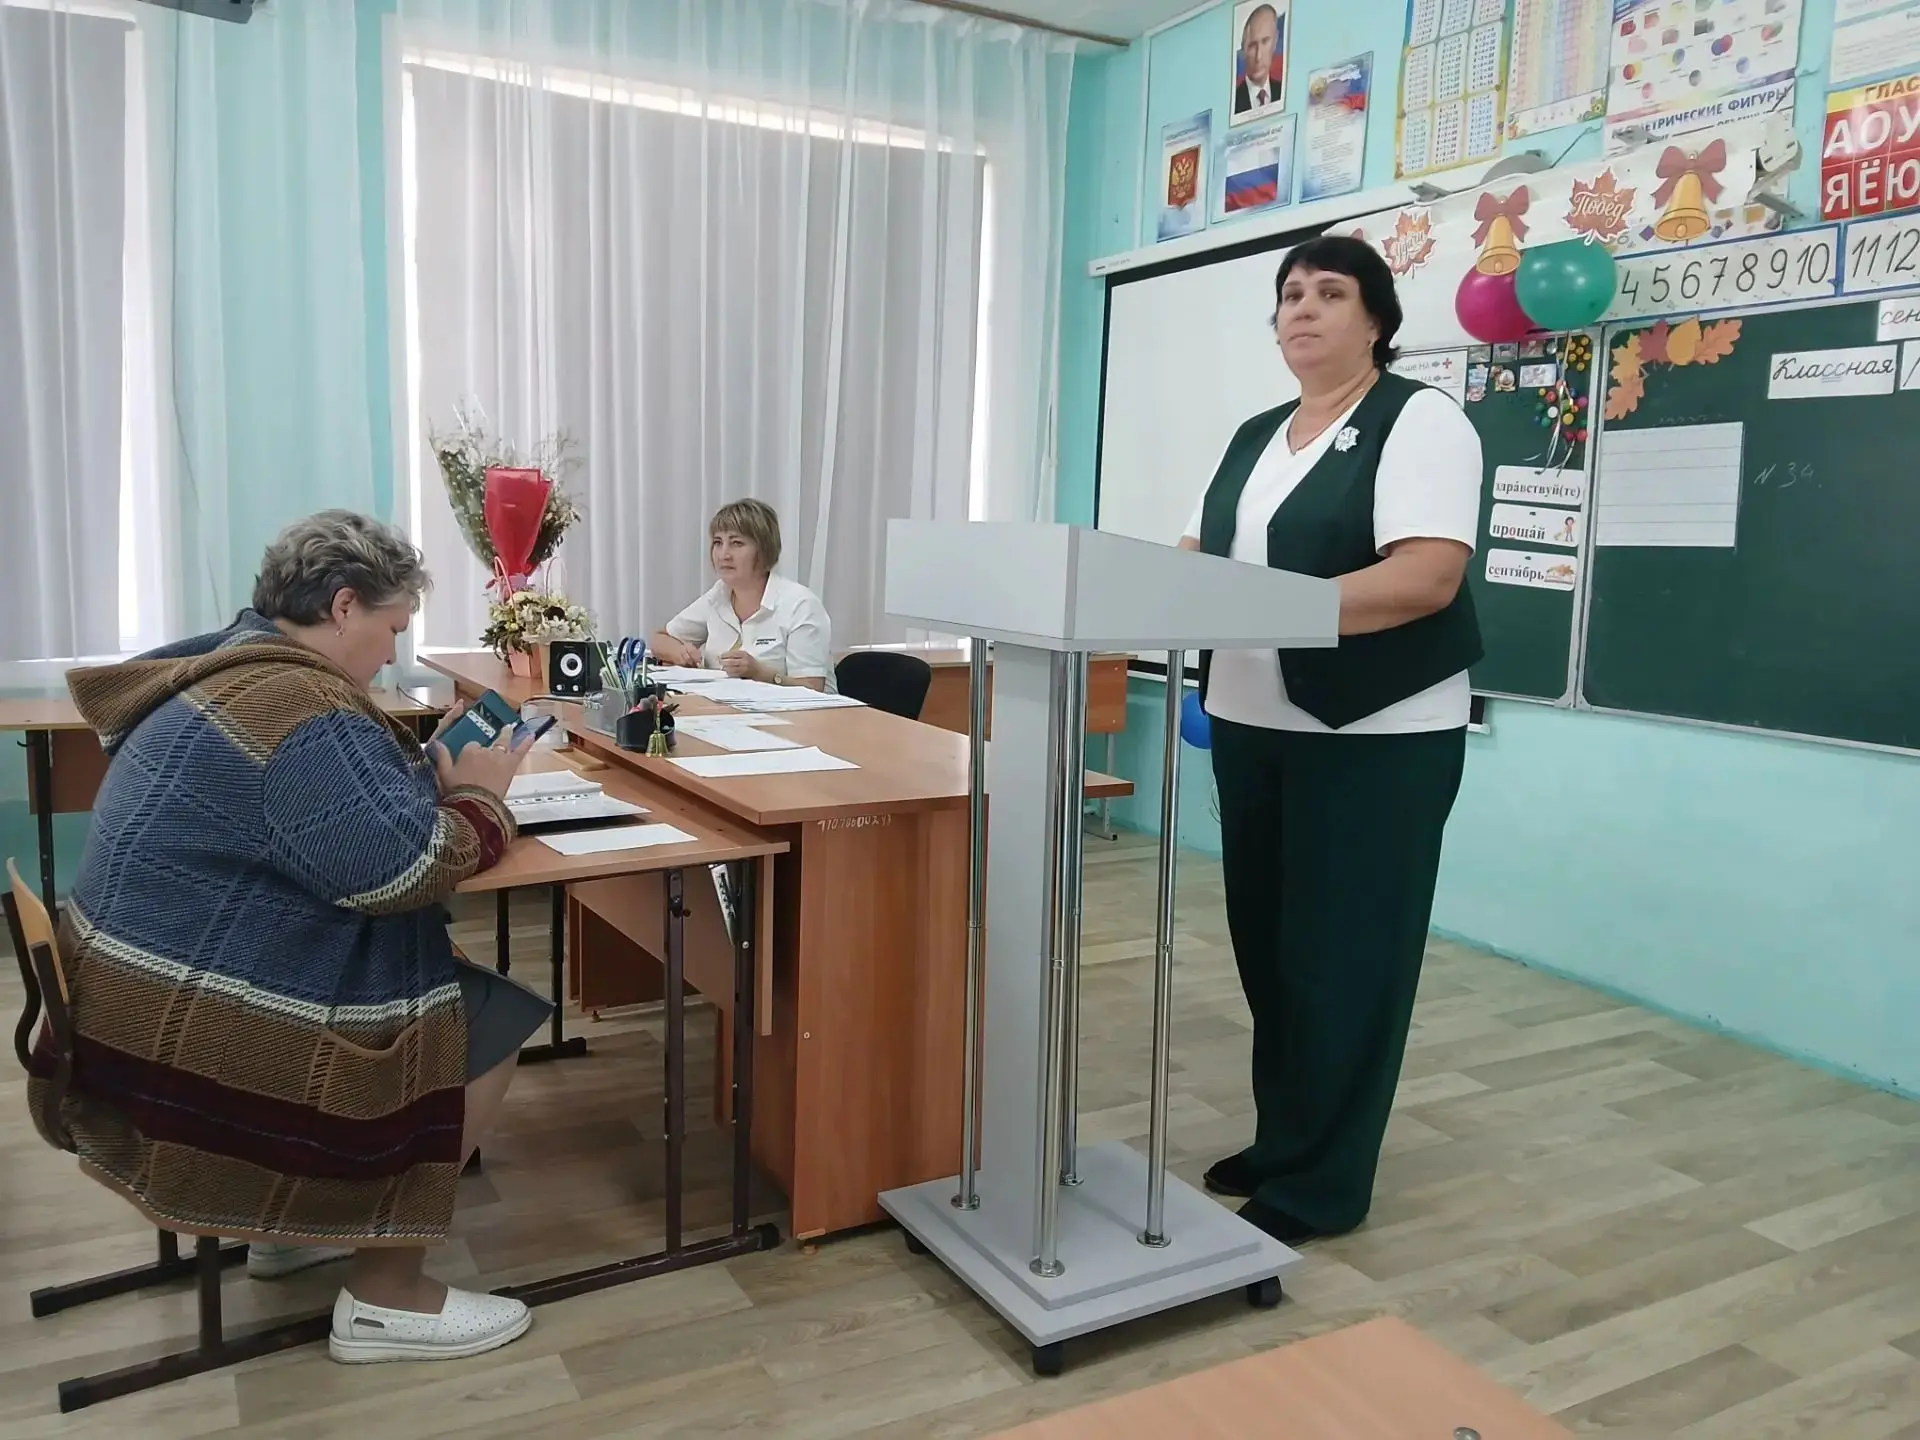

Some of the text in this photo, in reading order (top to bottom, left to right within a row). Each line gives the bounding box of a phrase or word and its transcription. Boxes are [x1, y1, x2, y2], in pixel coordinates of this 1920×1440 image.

[1728, 87, 1789, 111] ФИГУРЫ
[1823, 118, 1853, 159] А
[1860, 110, 1892, 150] О
[1572, 191, 1625, 229] Побед
[1824, 158, 1920, 213] Я Ё Ю
[1621, 242, 1831, 306] 4 5 6 7 8 9 10
[1851, 227, 1920, 279] 11 12
[1772, 355, 1895, 381] Классная
